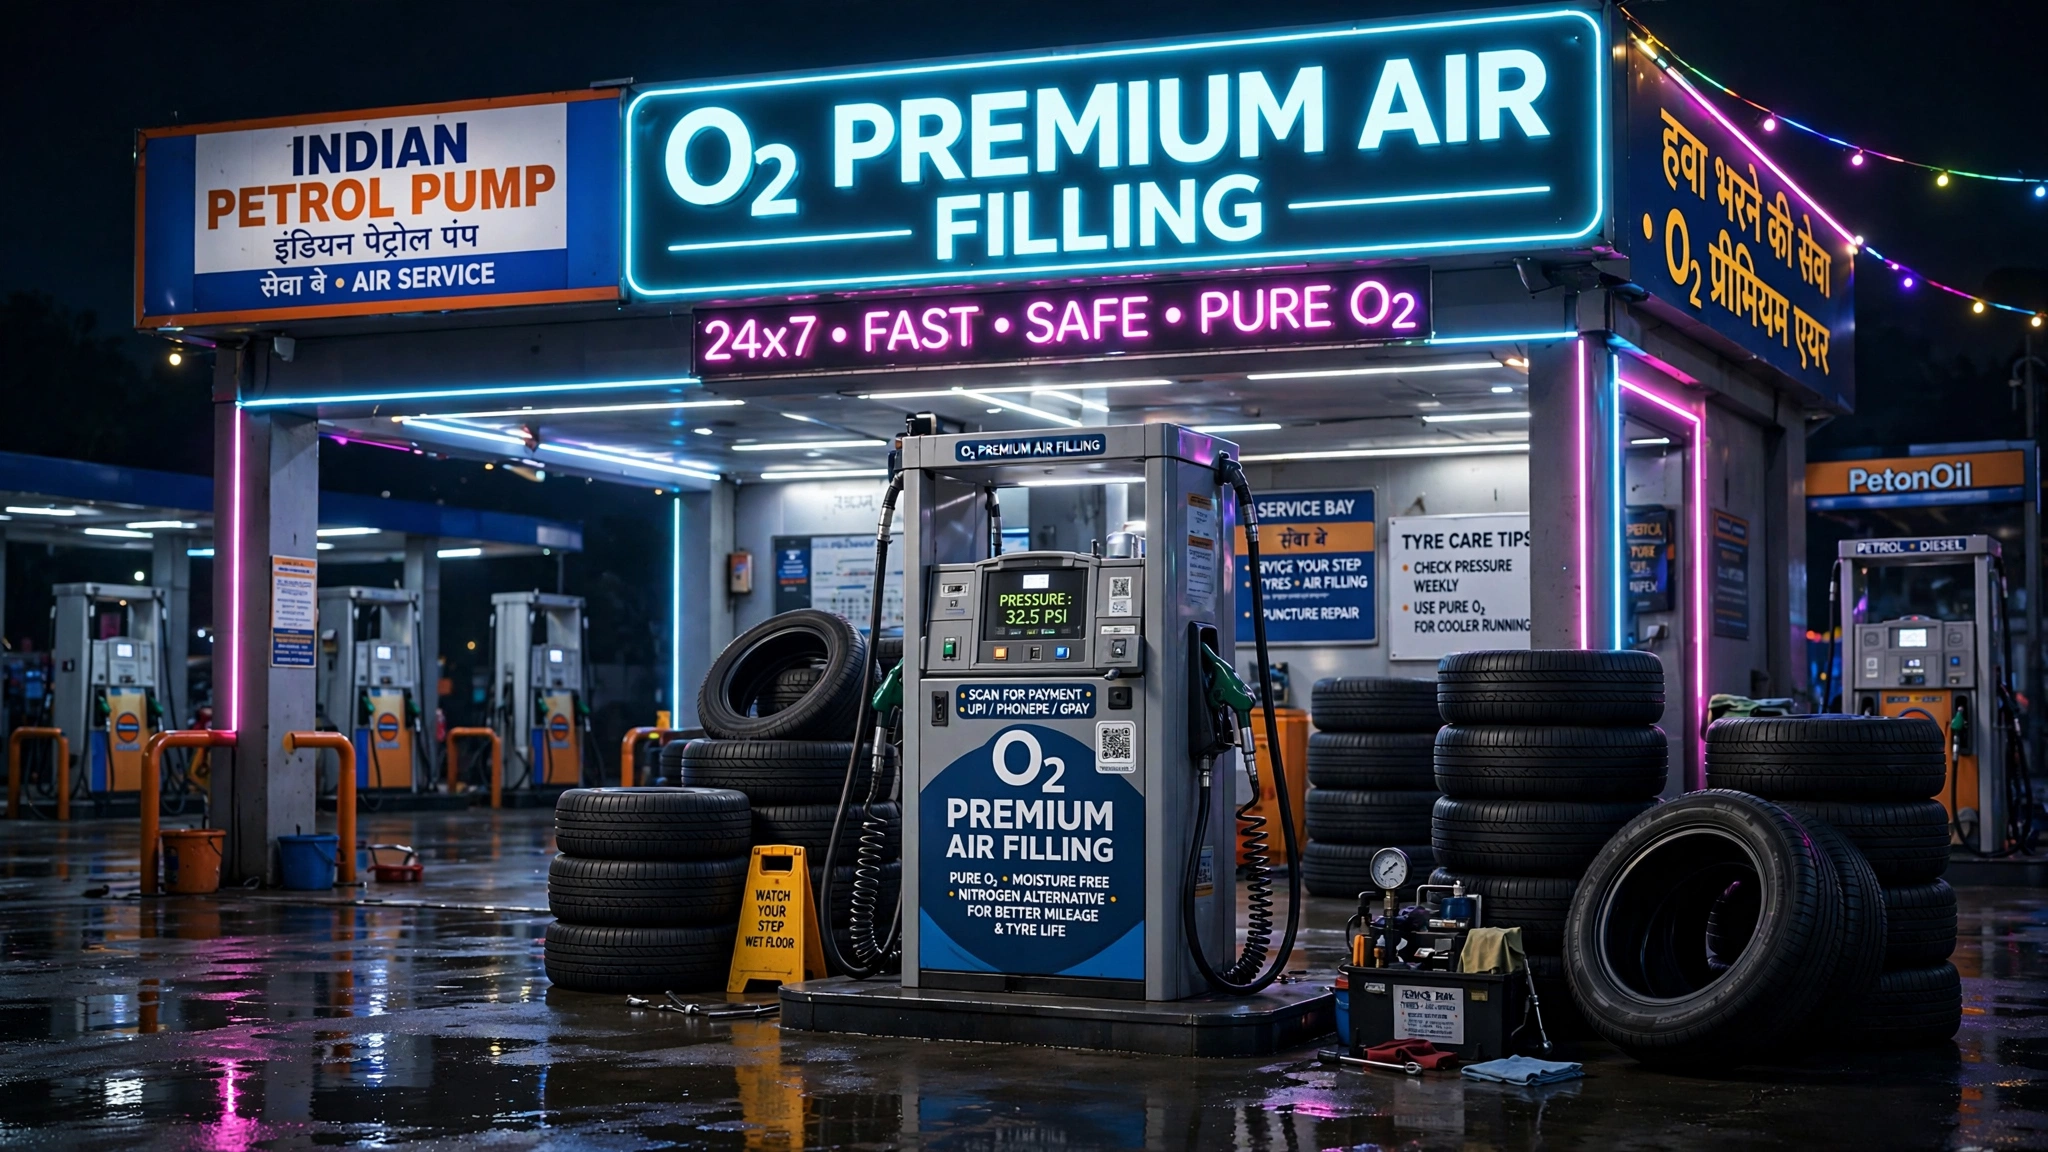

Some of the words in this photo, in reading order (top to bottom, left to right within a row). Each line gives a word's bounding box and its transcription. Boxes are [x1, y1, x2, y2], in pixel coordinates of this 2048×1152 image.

[834, 65, 1325, 188] PREMIUM
[1357, 48, 1551, 150] AIR
[292, 122, 468, 176] INDIAN
[207, 177, 395, 230] PETROL
[411, 164, 556, 215] PUMP
[1660, 107, 1708, 201] हवा
[1714, 156, 1763, 243] भरने
[1767, 190, 1794, 270] की
[1798, 213, 1832, 299] सेवा
[936, 173, 1263, 260] FILLING
[273, 228, 355, 265] इंडियन
[363, 221, 433, 259] पेट्रोल
[441, 219, 480, 249] पंप
[260, 271, 303, 298] सेवा
[309, 267, 328, 294] बे
[351, 269, 391, 293] AIR
[397, 261, 496, 290] SERVICE
[1708, 229, 1789, 348] प्रीमियम
[704, 315, 817, 361] 24x7
[864, 306, 980, 353] FAST
[1025, 296, 1149, 345] SAFE
[1200, 285, 1332, 335] PURE
[977, 441, 1031, 456] PREMIUM
[1033, 441, 1054, 455] AIR
[1055, 439, 1101, 453] FILLING
[1848, 461, 1972, 493] PetonOil
[1257, 500, 1321, 518] SERVICE
[1324, 499, 1355, 516] BAY
[1401, 533, 1444, 550] TYRE
[1449, 532, 1493, 549] CARE
[1497, 530, 1530, 547] TIPS
[1857, 541, 1904, 554] PETROL
[1920, 539, 1964, 552] DIESEL
[1296, 558, 1329, 573] YOUR
[1332, 557, 1362, 572] STEP
[1414, 560, 1452, 574] CHECK
[1455, 559, 1513, 573] PRESSURE
[1303, 576, 1322, 590] AIR
[1323, 575, 1368, 589] FILLING
[1413, 578, 1459, 593] WEEKLY
[1321, 606, 1360, 620] REPAIR
[1414, 601, 1436, 615] USE
[1439, 600, 1469, 614] PURE
[1005, 608, 1040, 625] 32.5
[1044, 608, 1067, 624] PSI
[1414, 620, 1436, 633] FOR
[1437, 619, 1480, 633] COOLER
[1482, 618, 1530, 632] RUNNING
[968, 688, 1000, 700] SCAN
[1003, 688, 1026, 700] FOR
[1028, 687, 1082, 701] PAYMENT
[967, 703, 986, 716] UPI
[996, 703, 1050, 715] PHONEPE
[1060, 702, 1090, 715] GPAY
[947, 797, 1113, 832] PREMIUM
[945, 833, 995, 860] AIR
[1003, 835, 1114, 863] FILLING
[949, 871, 981, 885] PURE
[1012, 874, 1076, 888] MOISTURE
[1079, 875, 1110, 889] FREE
[755, 889, 791, 902] WATCH
[958, 889, 1021, 902] NITROGEN
[1023, 890, 1105, 905] ALTERNATIVE
[757, 905, 786, 917] YOUR
[967, 905, 992, 918] FOR
[995, 906, 1041, 920] BETTER
[1045, 908, 1099, 922] MILEAGE
[758, 920, 784, 932] STEP
[994, 922, 1004, 936] &
[1006, 923, 1037, 936] TYRE
[1040, 924, 1066, 938] LIFE
[745, 936, 764, 947] WET
[765, 936, 795, 948] FLOOR
